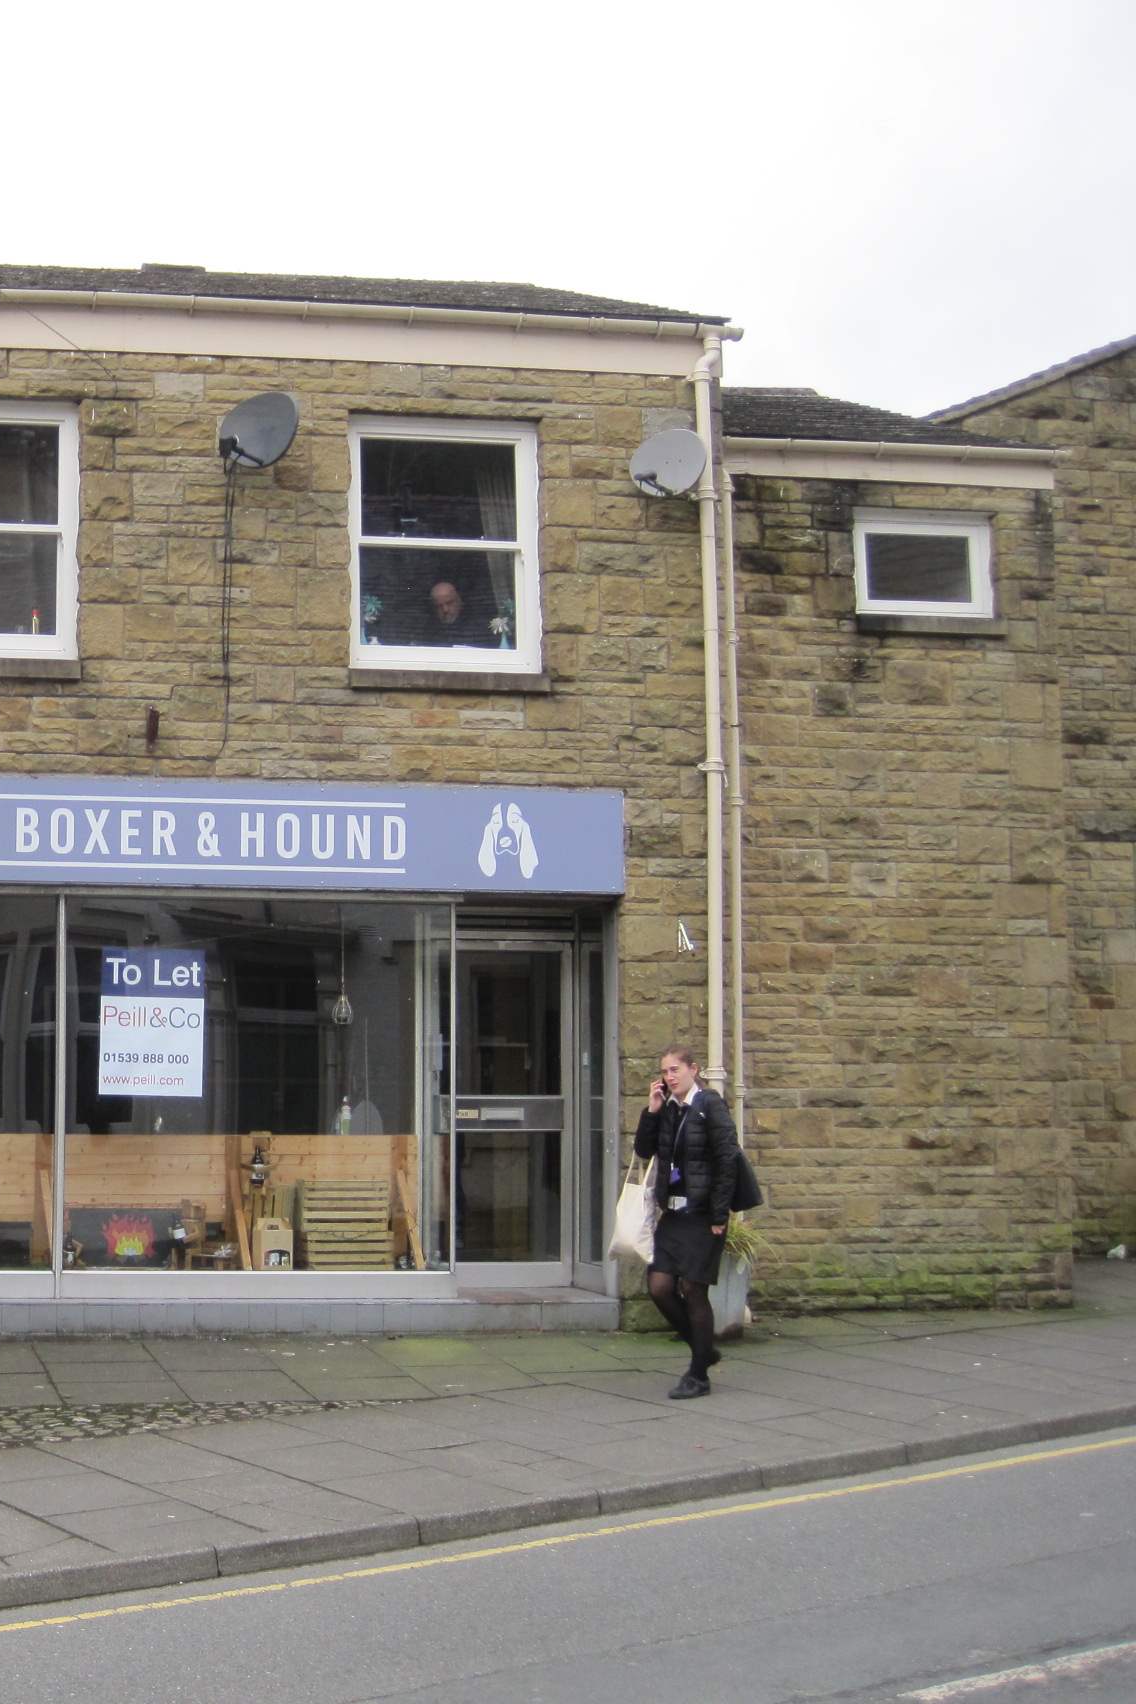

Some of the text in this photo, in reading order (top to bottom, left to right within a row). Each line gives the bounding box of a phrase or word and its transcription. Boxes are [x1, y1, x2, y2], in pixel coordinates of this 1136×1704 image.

[15, 807, 177, 856] BOXER
[197, 811, 222, 858] &
[240, 812, 406, 861] HOUND
[106, 957, 201, 988] To Let
[103, 1005, 200, 1029] Peill&Co
[103, 1052, 190, 1065] 01539 888 000
[102, 1074, 184, 1087] www.peill.com
